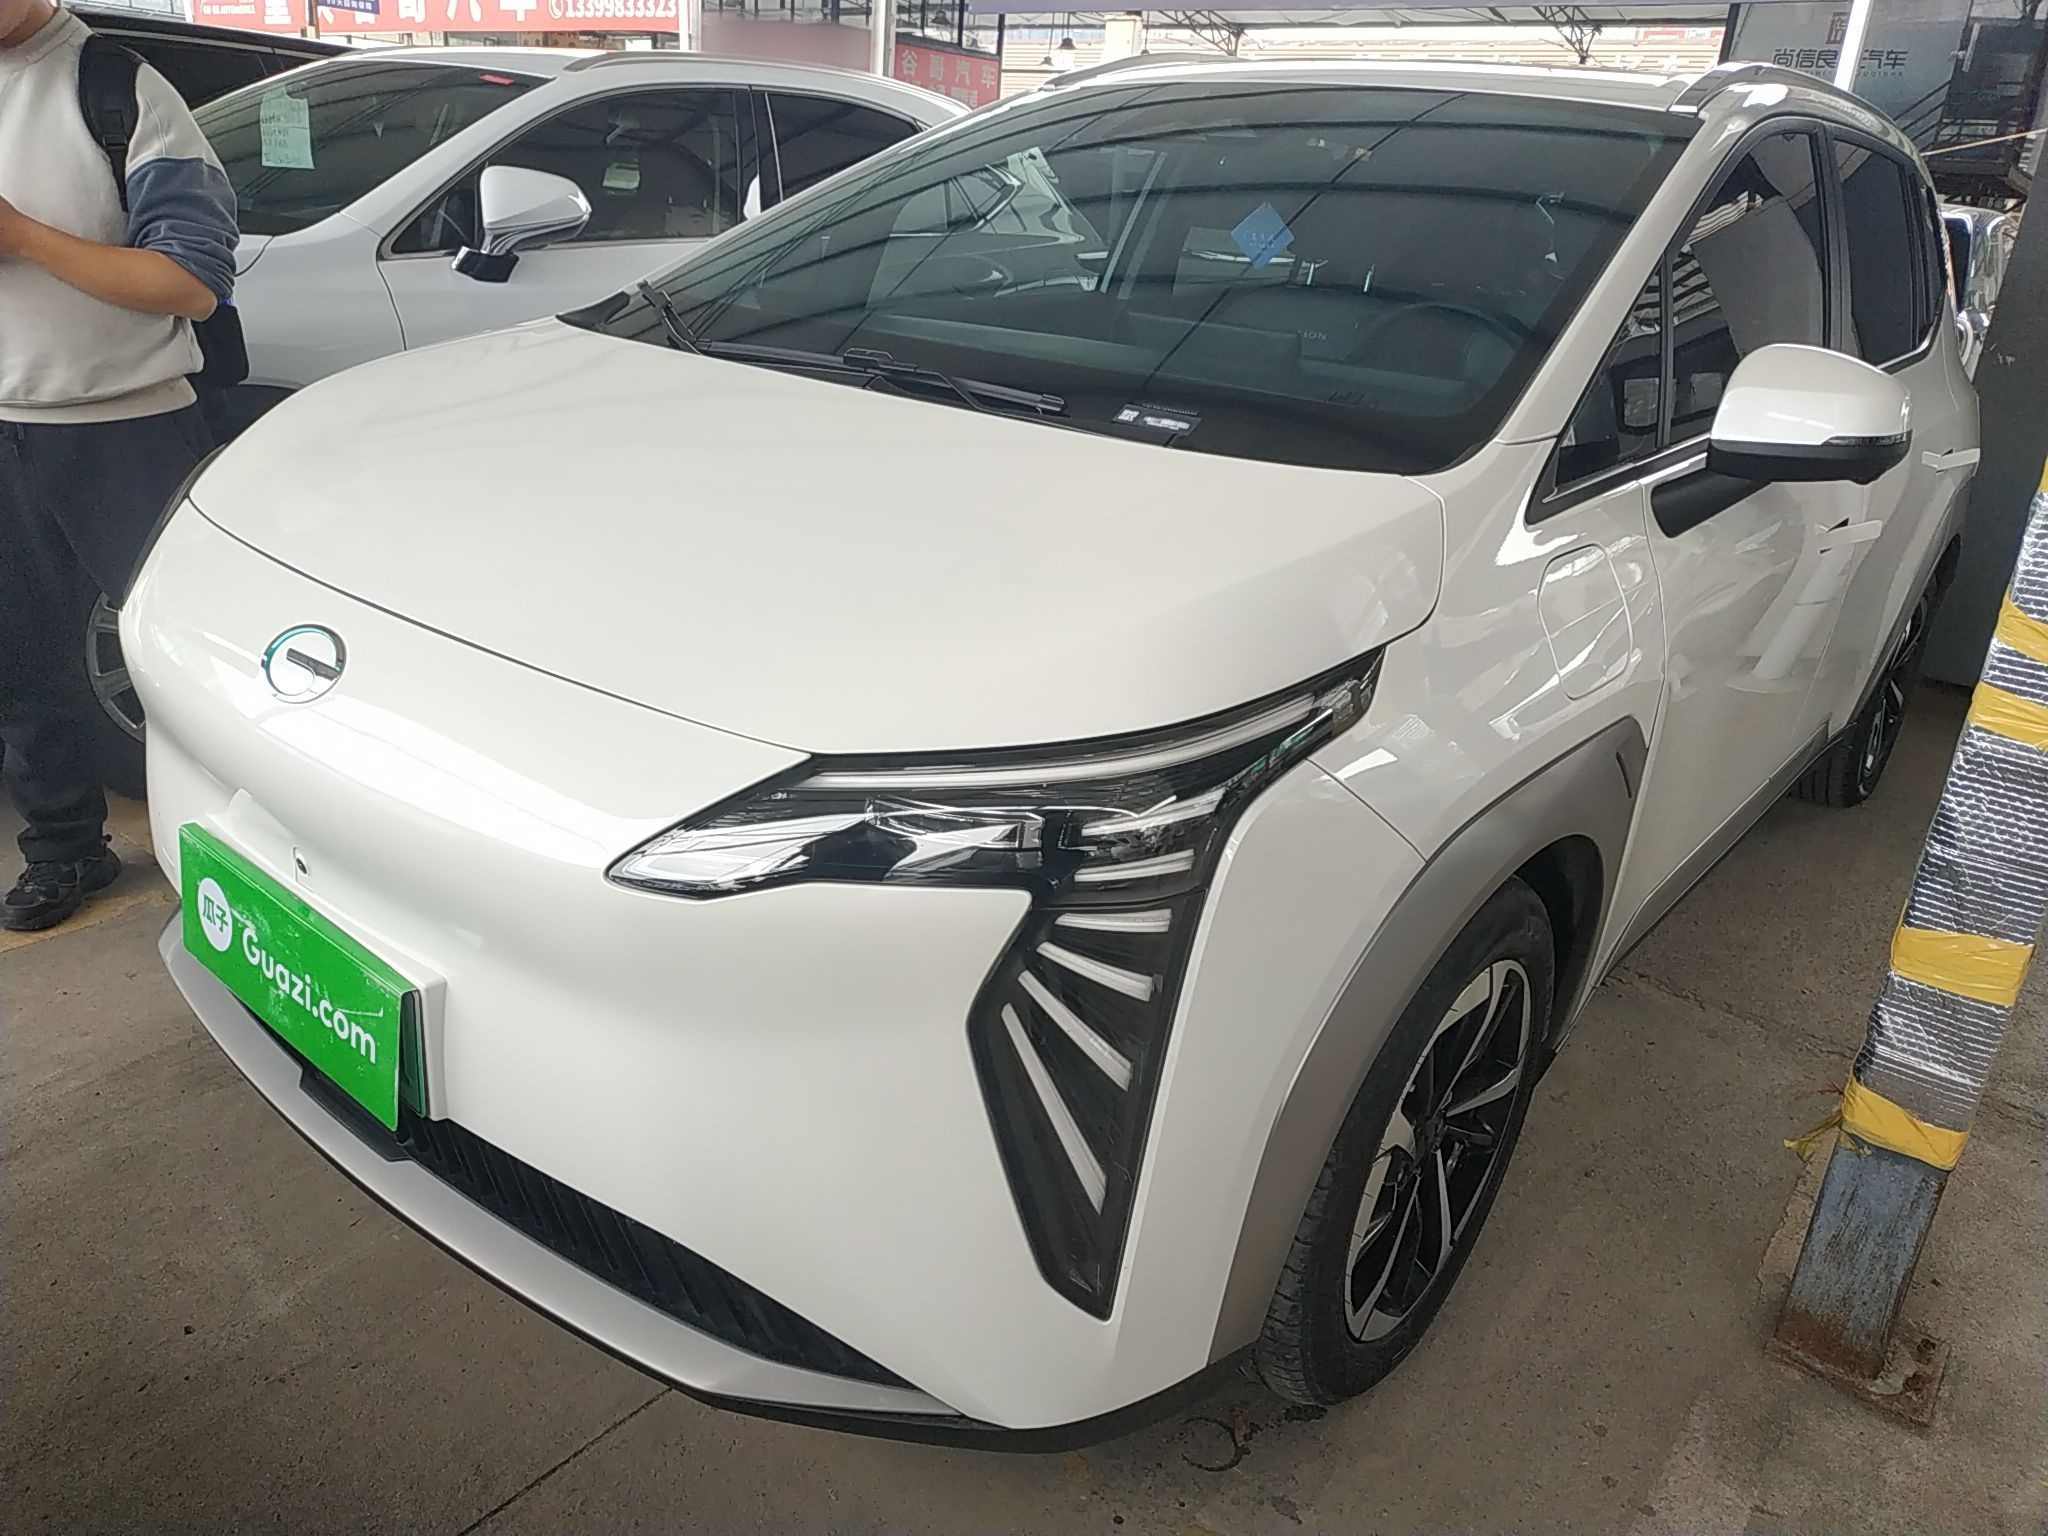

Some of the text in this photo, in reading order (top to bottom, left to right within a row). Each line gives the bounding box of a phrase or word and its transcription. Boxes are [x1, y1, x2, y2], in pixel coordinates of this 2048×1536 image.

[1773, 48, 1909, 69] 尚信良汽车
[202, 894, 229, 933] 瓜子
[242, 927, 376, 1064] Guazi.com
